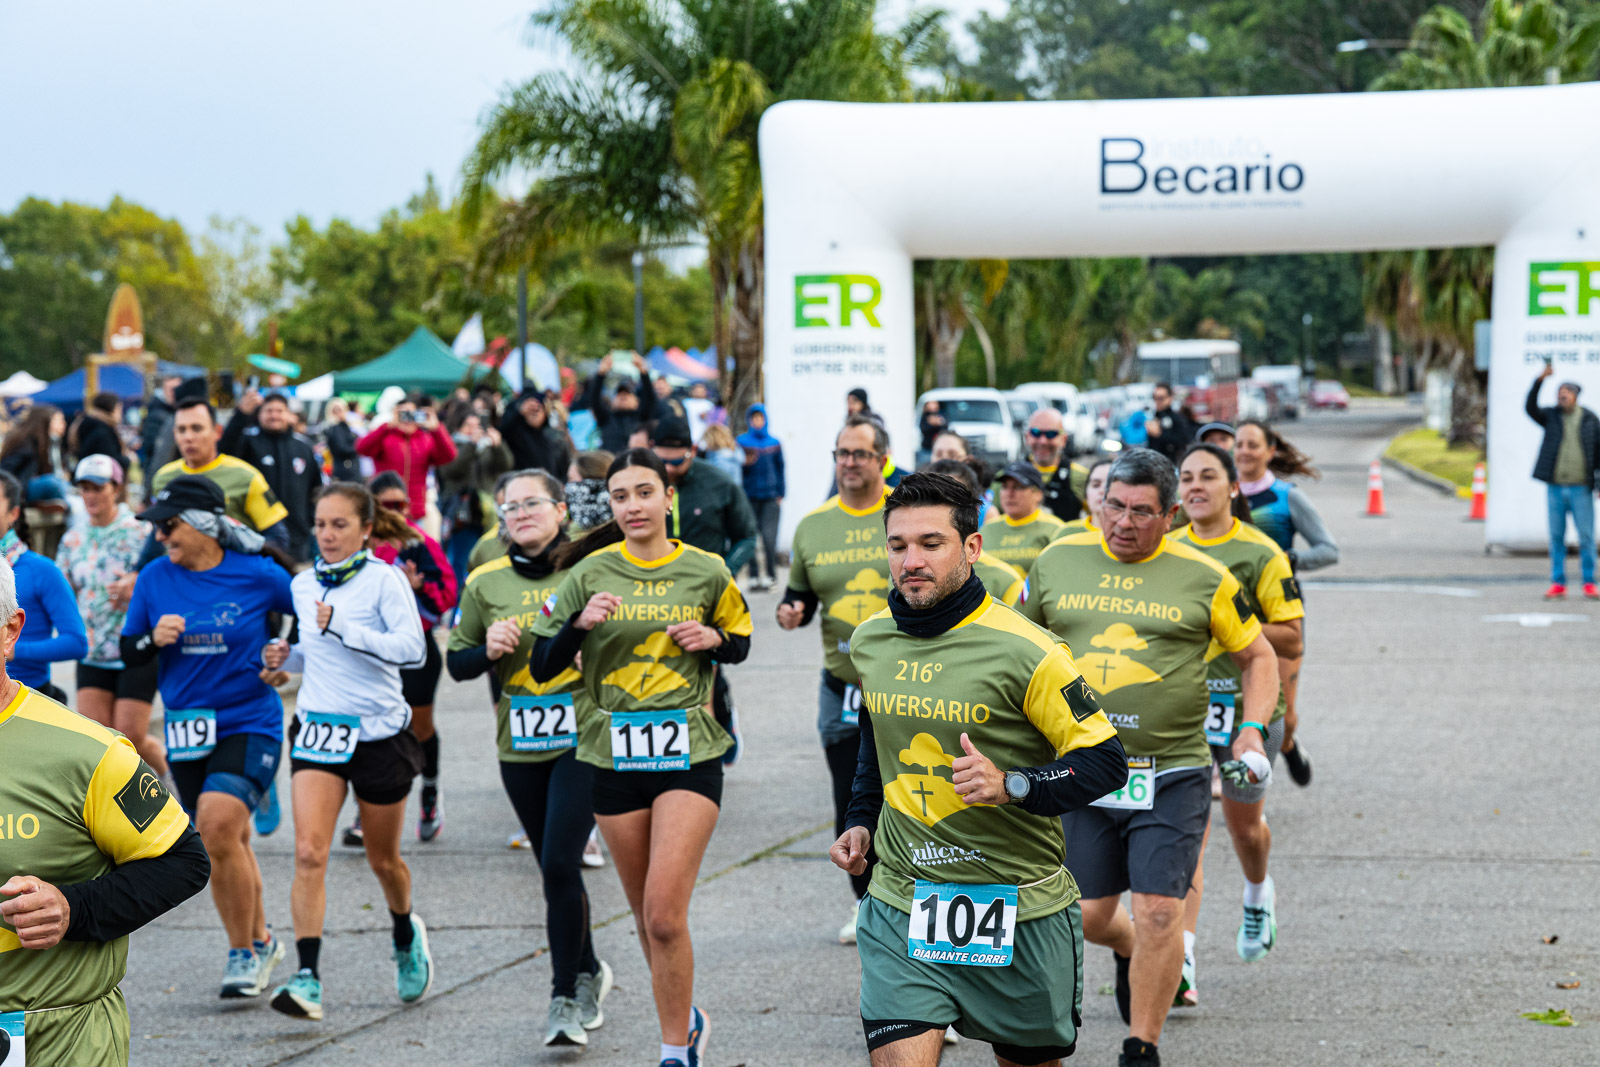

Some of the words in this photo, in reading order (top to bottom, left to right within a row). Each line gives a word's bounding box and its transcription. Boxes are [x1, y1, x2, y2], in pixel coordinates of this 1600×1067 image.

[1101, 137, 1305, 194] Becario
[794, 273, 881, 328] ER
[1056, 593, 1183, 623] ANIVERSARIO
[516, 703, 569, 738] 122
[863, 690, 991, 724] NIVERSARIO
[1105, 713, 1139, 724] roc
[1209, 702, 1226, 732] 3
[171, 716, 209, 748] 119
[303, 720, 351, 754] 023
[618, 720, 682, 759] 112
[617, 761, 657, 770] DIAMANTE
[658, 760, 686, 769] CORRE
[920, 893, 1007, 950] 104
[913, 948, 969, 962] DIAMANTE
[970, 953, 1008, 965] CORRE
